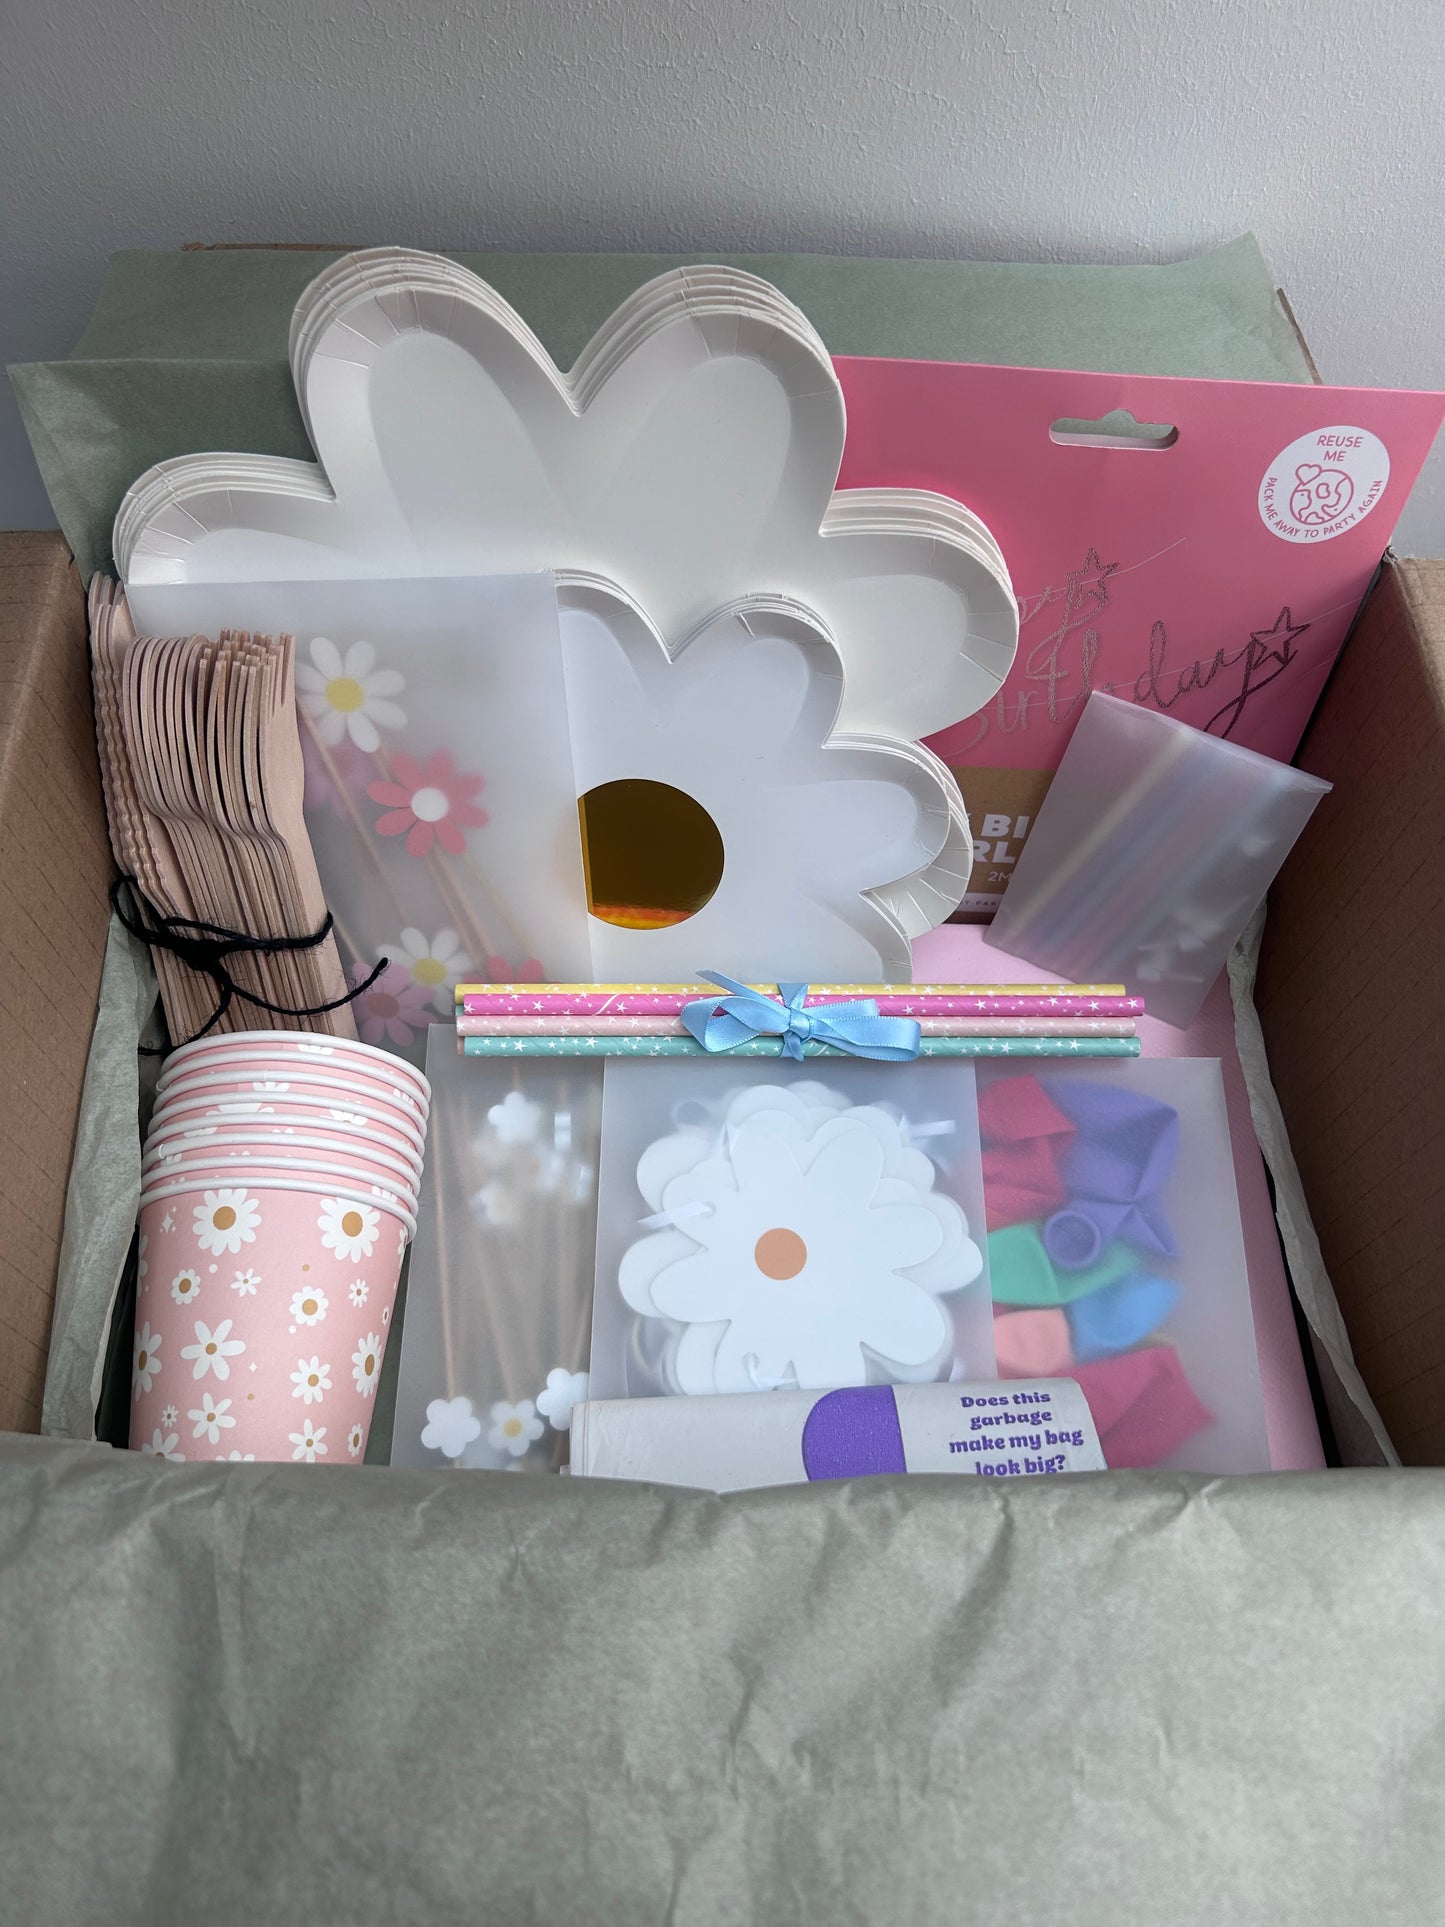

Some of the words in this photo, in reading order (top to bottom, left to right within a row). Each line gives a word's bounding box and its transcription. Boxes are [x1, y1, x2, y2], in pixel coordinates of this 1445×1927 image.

[1317, 435, 1364, 448] REUSE
[1323, 450, 1346, 462] ME
[1263, 477, 1278, 502] PACK
[1358, 480, 1383, 513] AGAIN
[1264, 503, 1278, 521] ME
[1273, 519, 1301, 537] AWAY
[1304, 529, 1319, 538] TO
[1323, 513, 1357, 535] PARTY
[981, 813, 1030, 839] BI
[973, 840, 1016, 864] RL
[960, 1395, 1009, 1408] Does
[1012, 1392, 1051, 1405] this
[970, 1410, 1052, 1431] garbage
[949, 1435, 1005, 1454] make
[1008, 1433, 1041, 1451] my
[1044, 1429, 1084, 1446] bag
[975, 1459, 1021, 1477] look
[1024, 1454, 1066, 1474] big?
